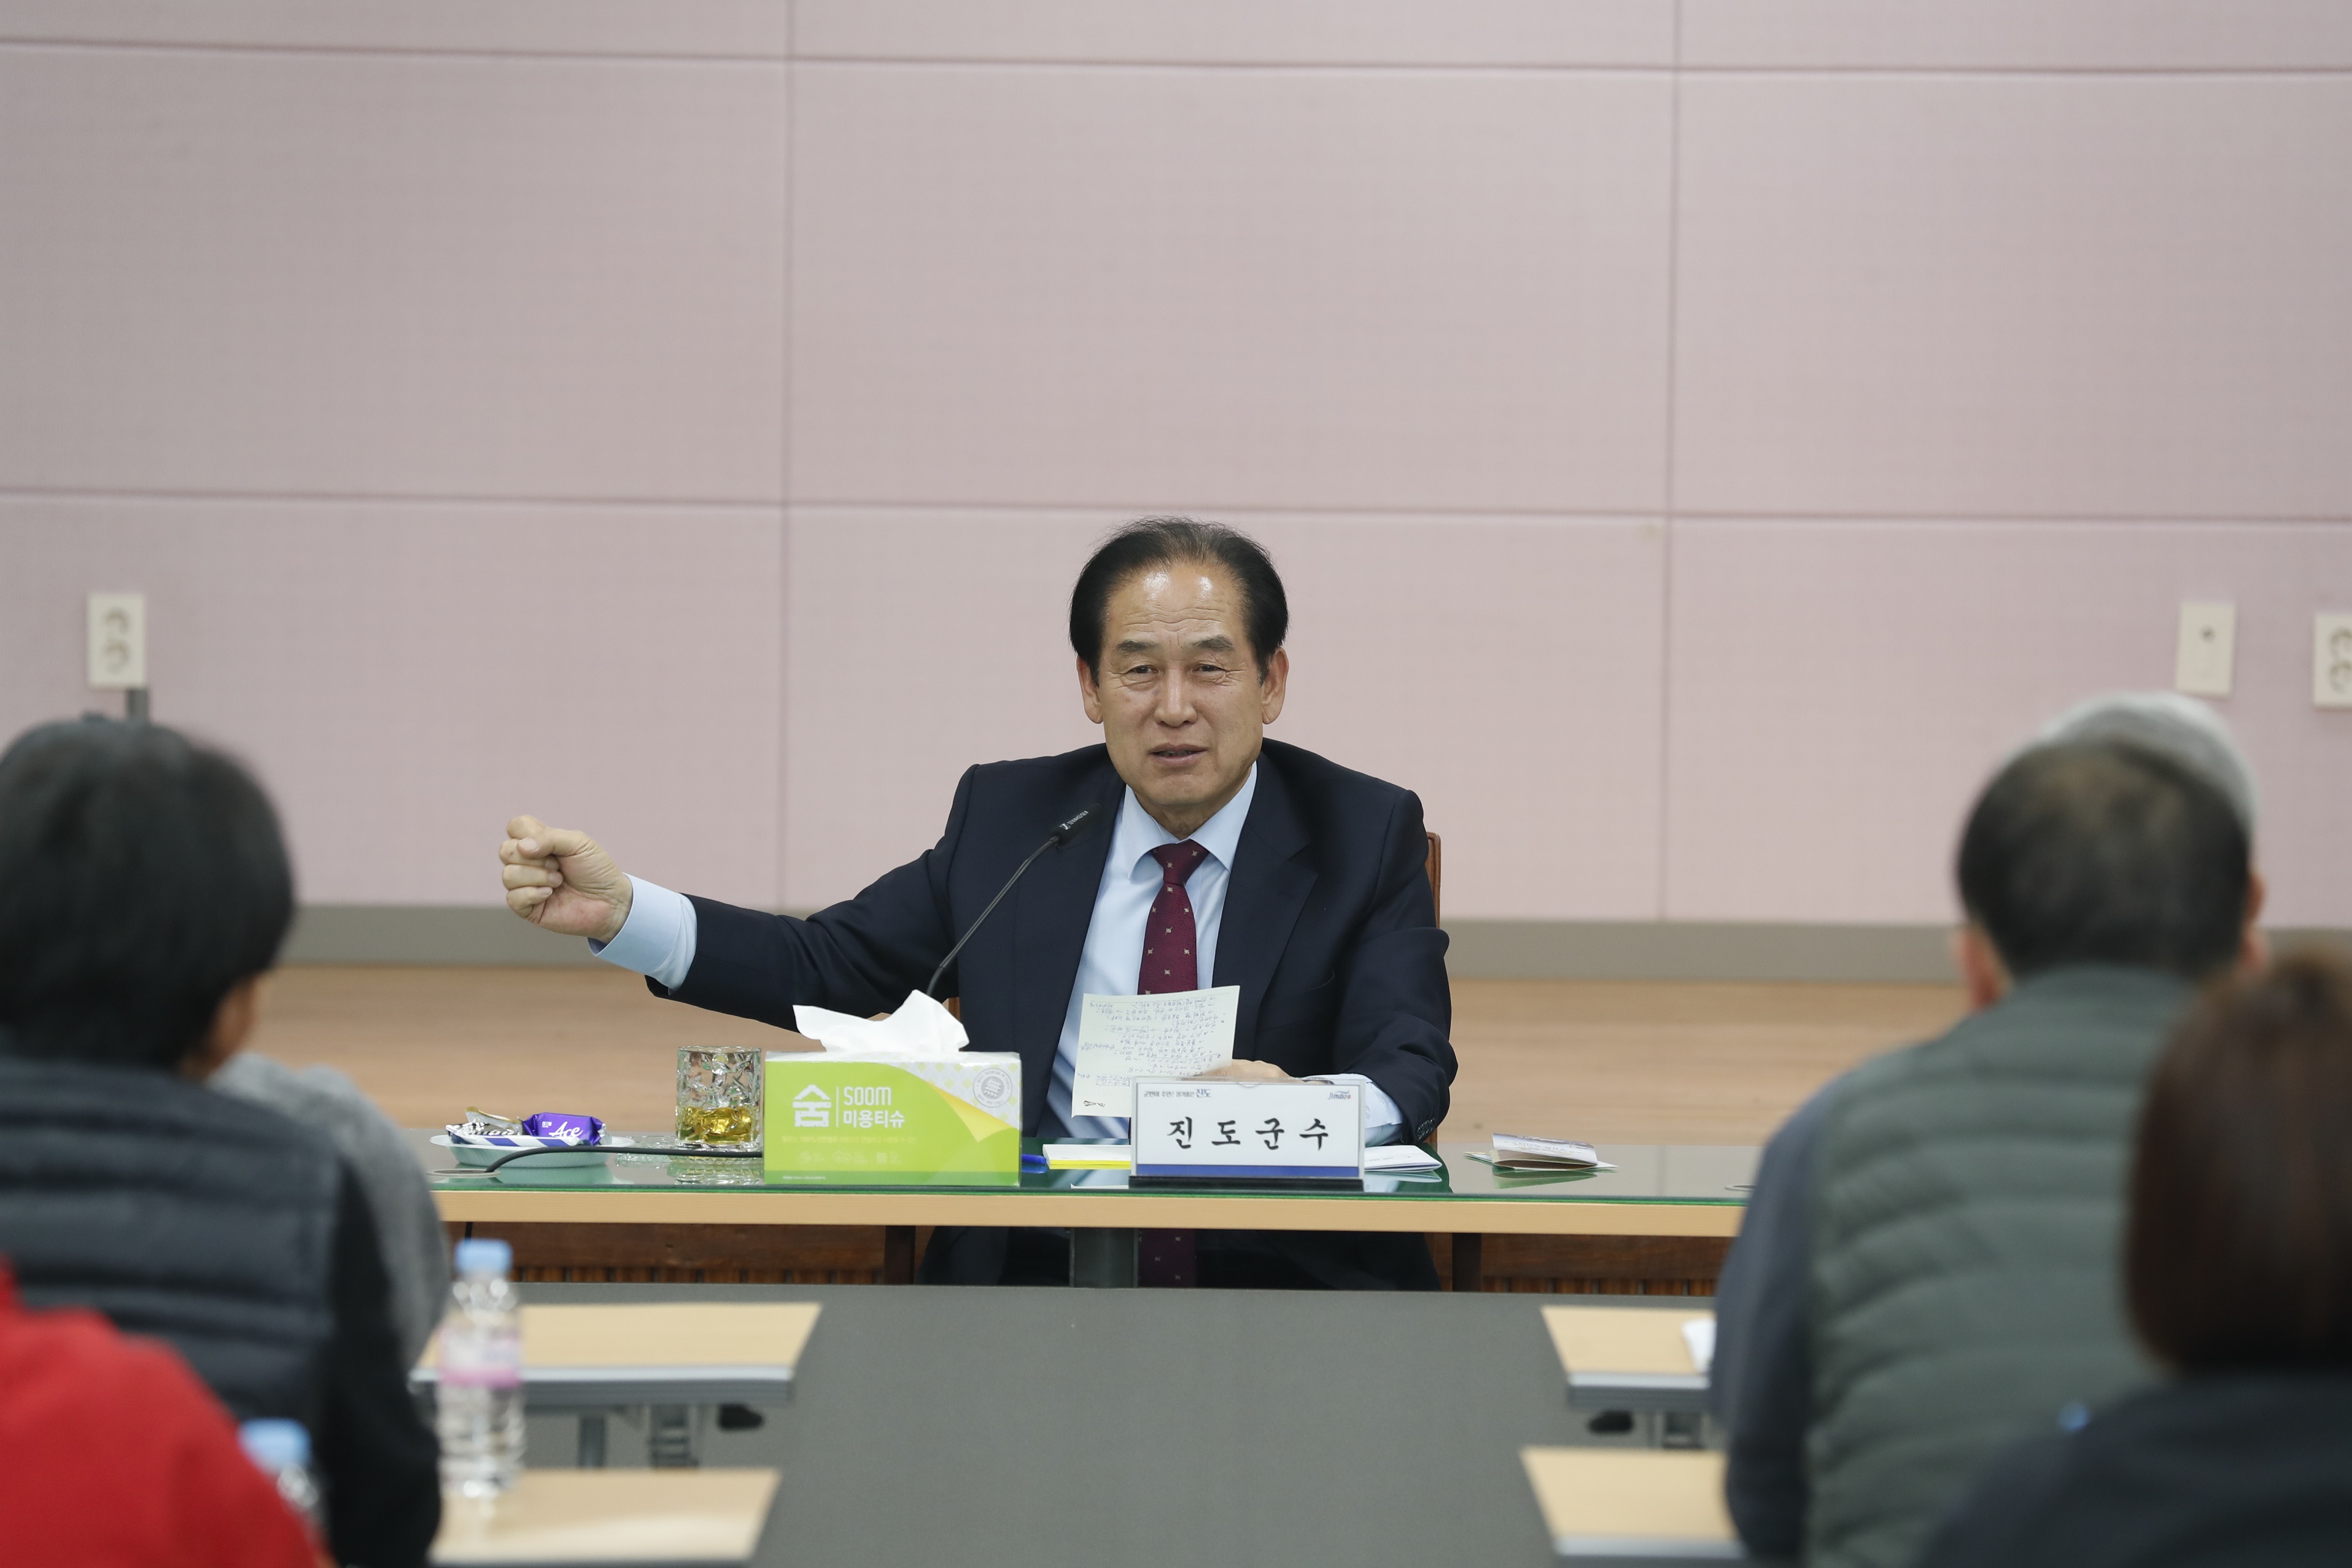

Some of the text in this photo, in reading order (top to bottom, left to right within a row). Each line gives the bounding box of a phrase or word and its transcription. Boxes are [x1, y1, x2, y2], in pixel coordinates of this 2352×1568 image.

[1196, 1089, 1212, 1098] 진도
[792, 1084, 832, 1127] 숨
[843, 1110, 905, 1128] 미용티슈
[548, 1121, 584, 1137] Ace
